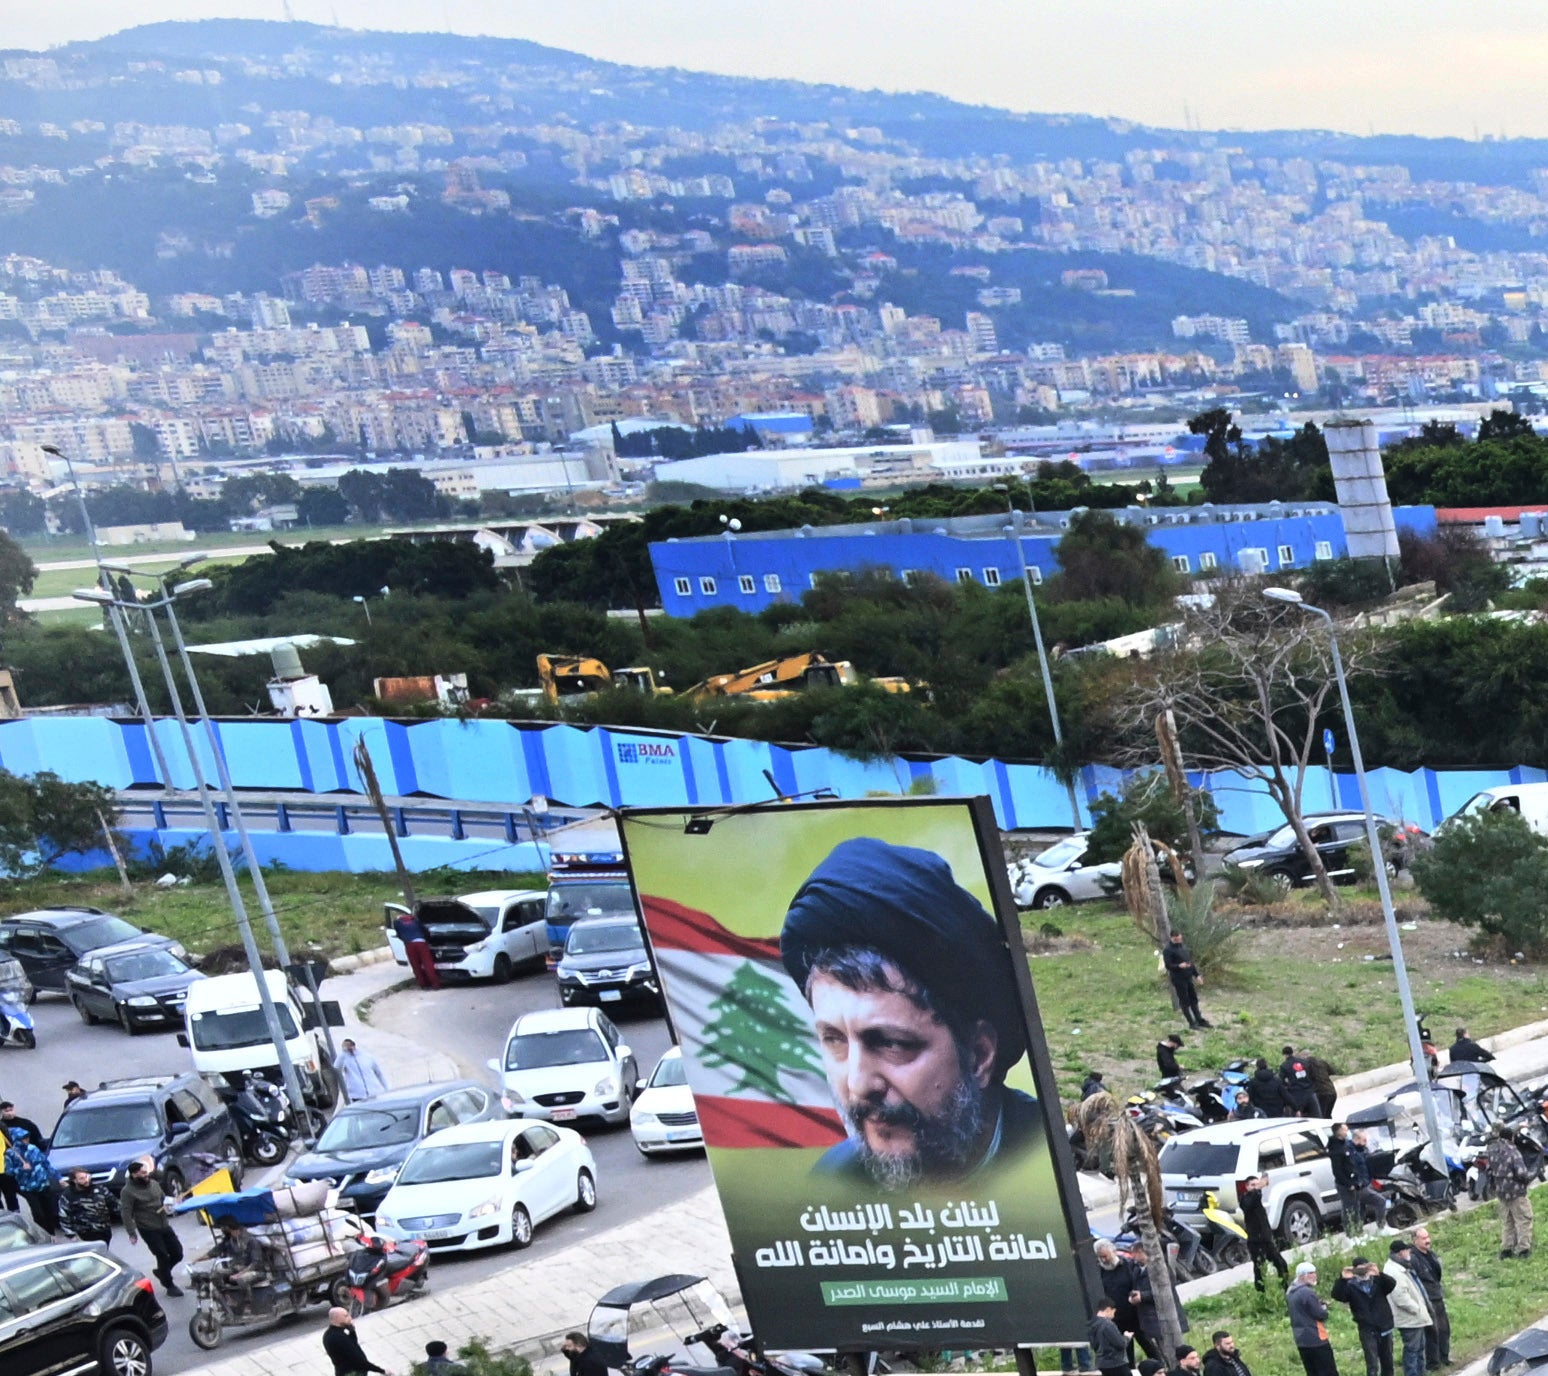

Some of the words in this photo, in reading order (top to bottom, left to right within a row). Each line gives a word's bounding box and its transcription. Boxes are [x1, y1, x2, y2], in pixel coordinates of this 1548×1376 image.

[638, 743, 675, 757] BMA
[799, 1202, 894, 1236] الإنسان
[898, 1202, 936, 1235] بلد
[939, 1200, 1000, 1233] لبنان
[755, 1240, 805, 1268] الله
[902, 1234, 985, 1270] التاريخ
[830, 1284, 866, 1302] الصدر
[869, 1287, 917, 1301] موسى
[920, 1282, 959, 1299] السيد
[962, 1280, 999, 1298] الإمام
[886, 1321, 912, 1332] هشام
[913, 1321, 931, 1332] علي
[960, 1318, 985, 1329] تقدمة
